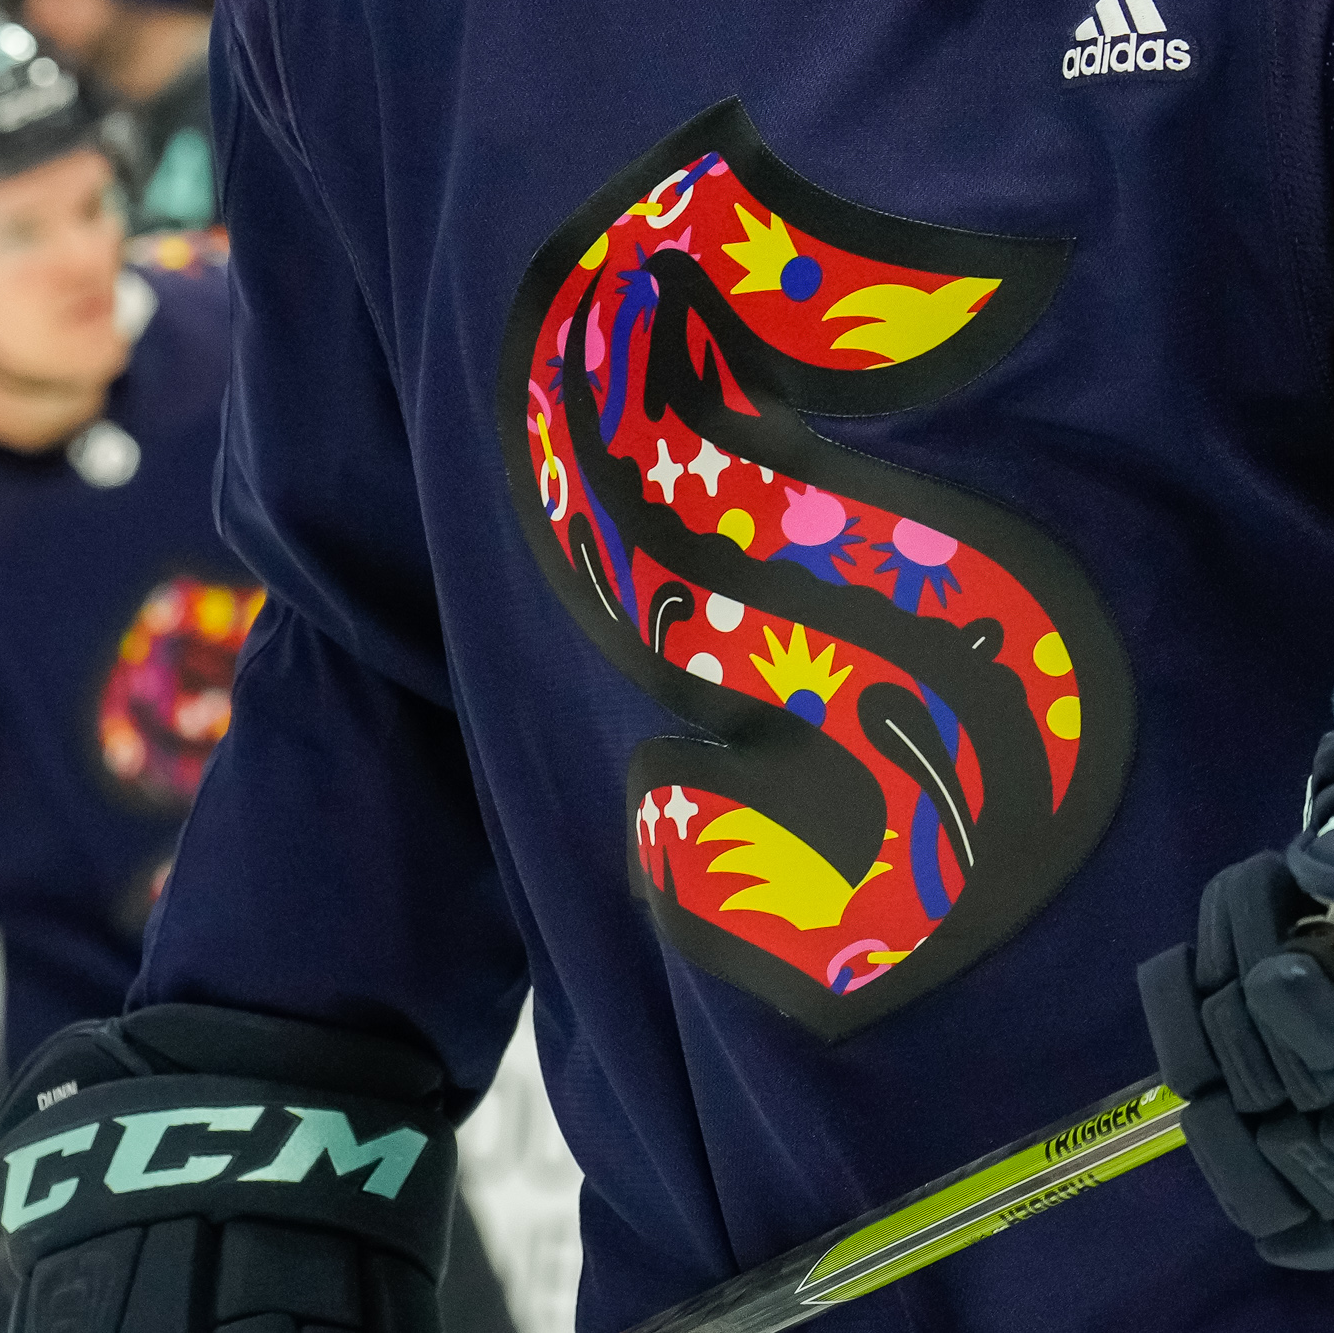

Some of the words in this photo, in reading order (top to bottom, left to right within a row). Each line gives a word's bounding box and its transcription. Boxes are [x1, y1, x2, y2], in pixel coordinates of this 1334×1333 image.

[1062, 33, 1191, 79] adidas
[37, 1080, 78, 1112] DUNN
[1043, 1096, 1143, 1163] TRIGGER
[0, 1106, 429, 1234] CCM
